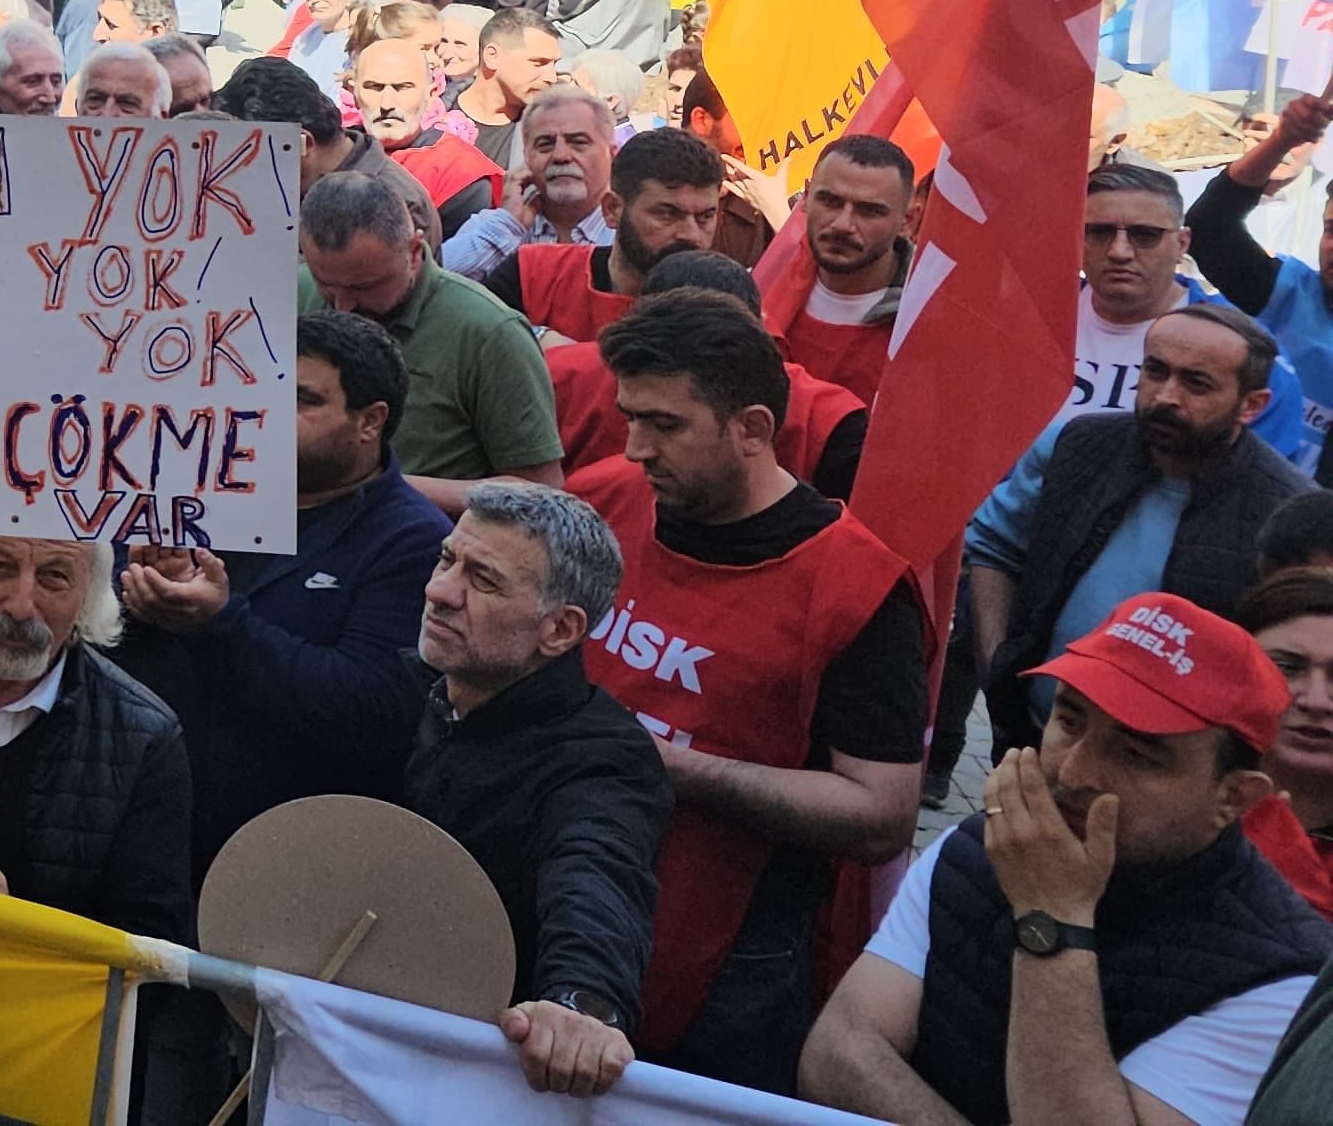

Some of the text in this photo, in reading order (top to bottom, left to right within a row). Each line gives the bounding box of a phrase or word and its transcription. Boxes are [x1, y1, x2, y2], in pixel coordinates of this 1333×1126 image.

[759, 46, 891, 171] HALKEVL
[67, 123, 296, 246] YOK!
[27, 236, 223, 312] YOK!
[79, 295, 287, 388] YOK!
[3, 392, 267, 507] ÇÖKME
[52, 488, 213, 549] VAR
[1105, 623, 1196, 676] GENEL-İŞ
[1129, 605, 1195, 647] DİSK
